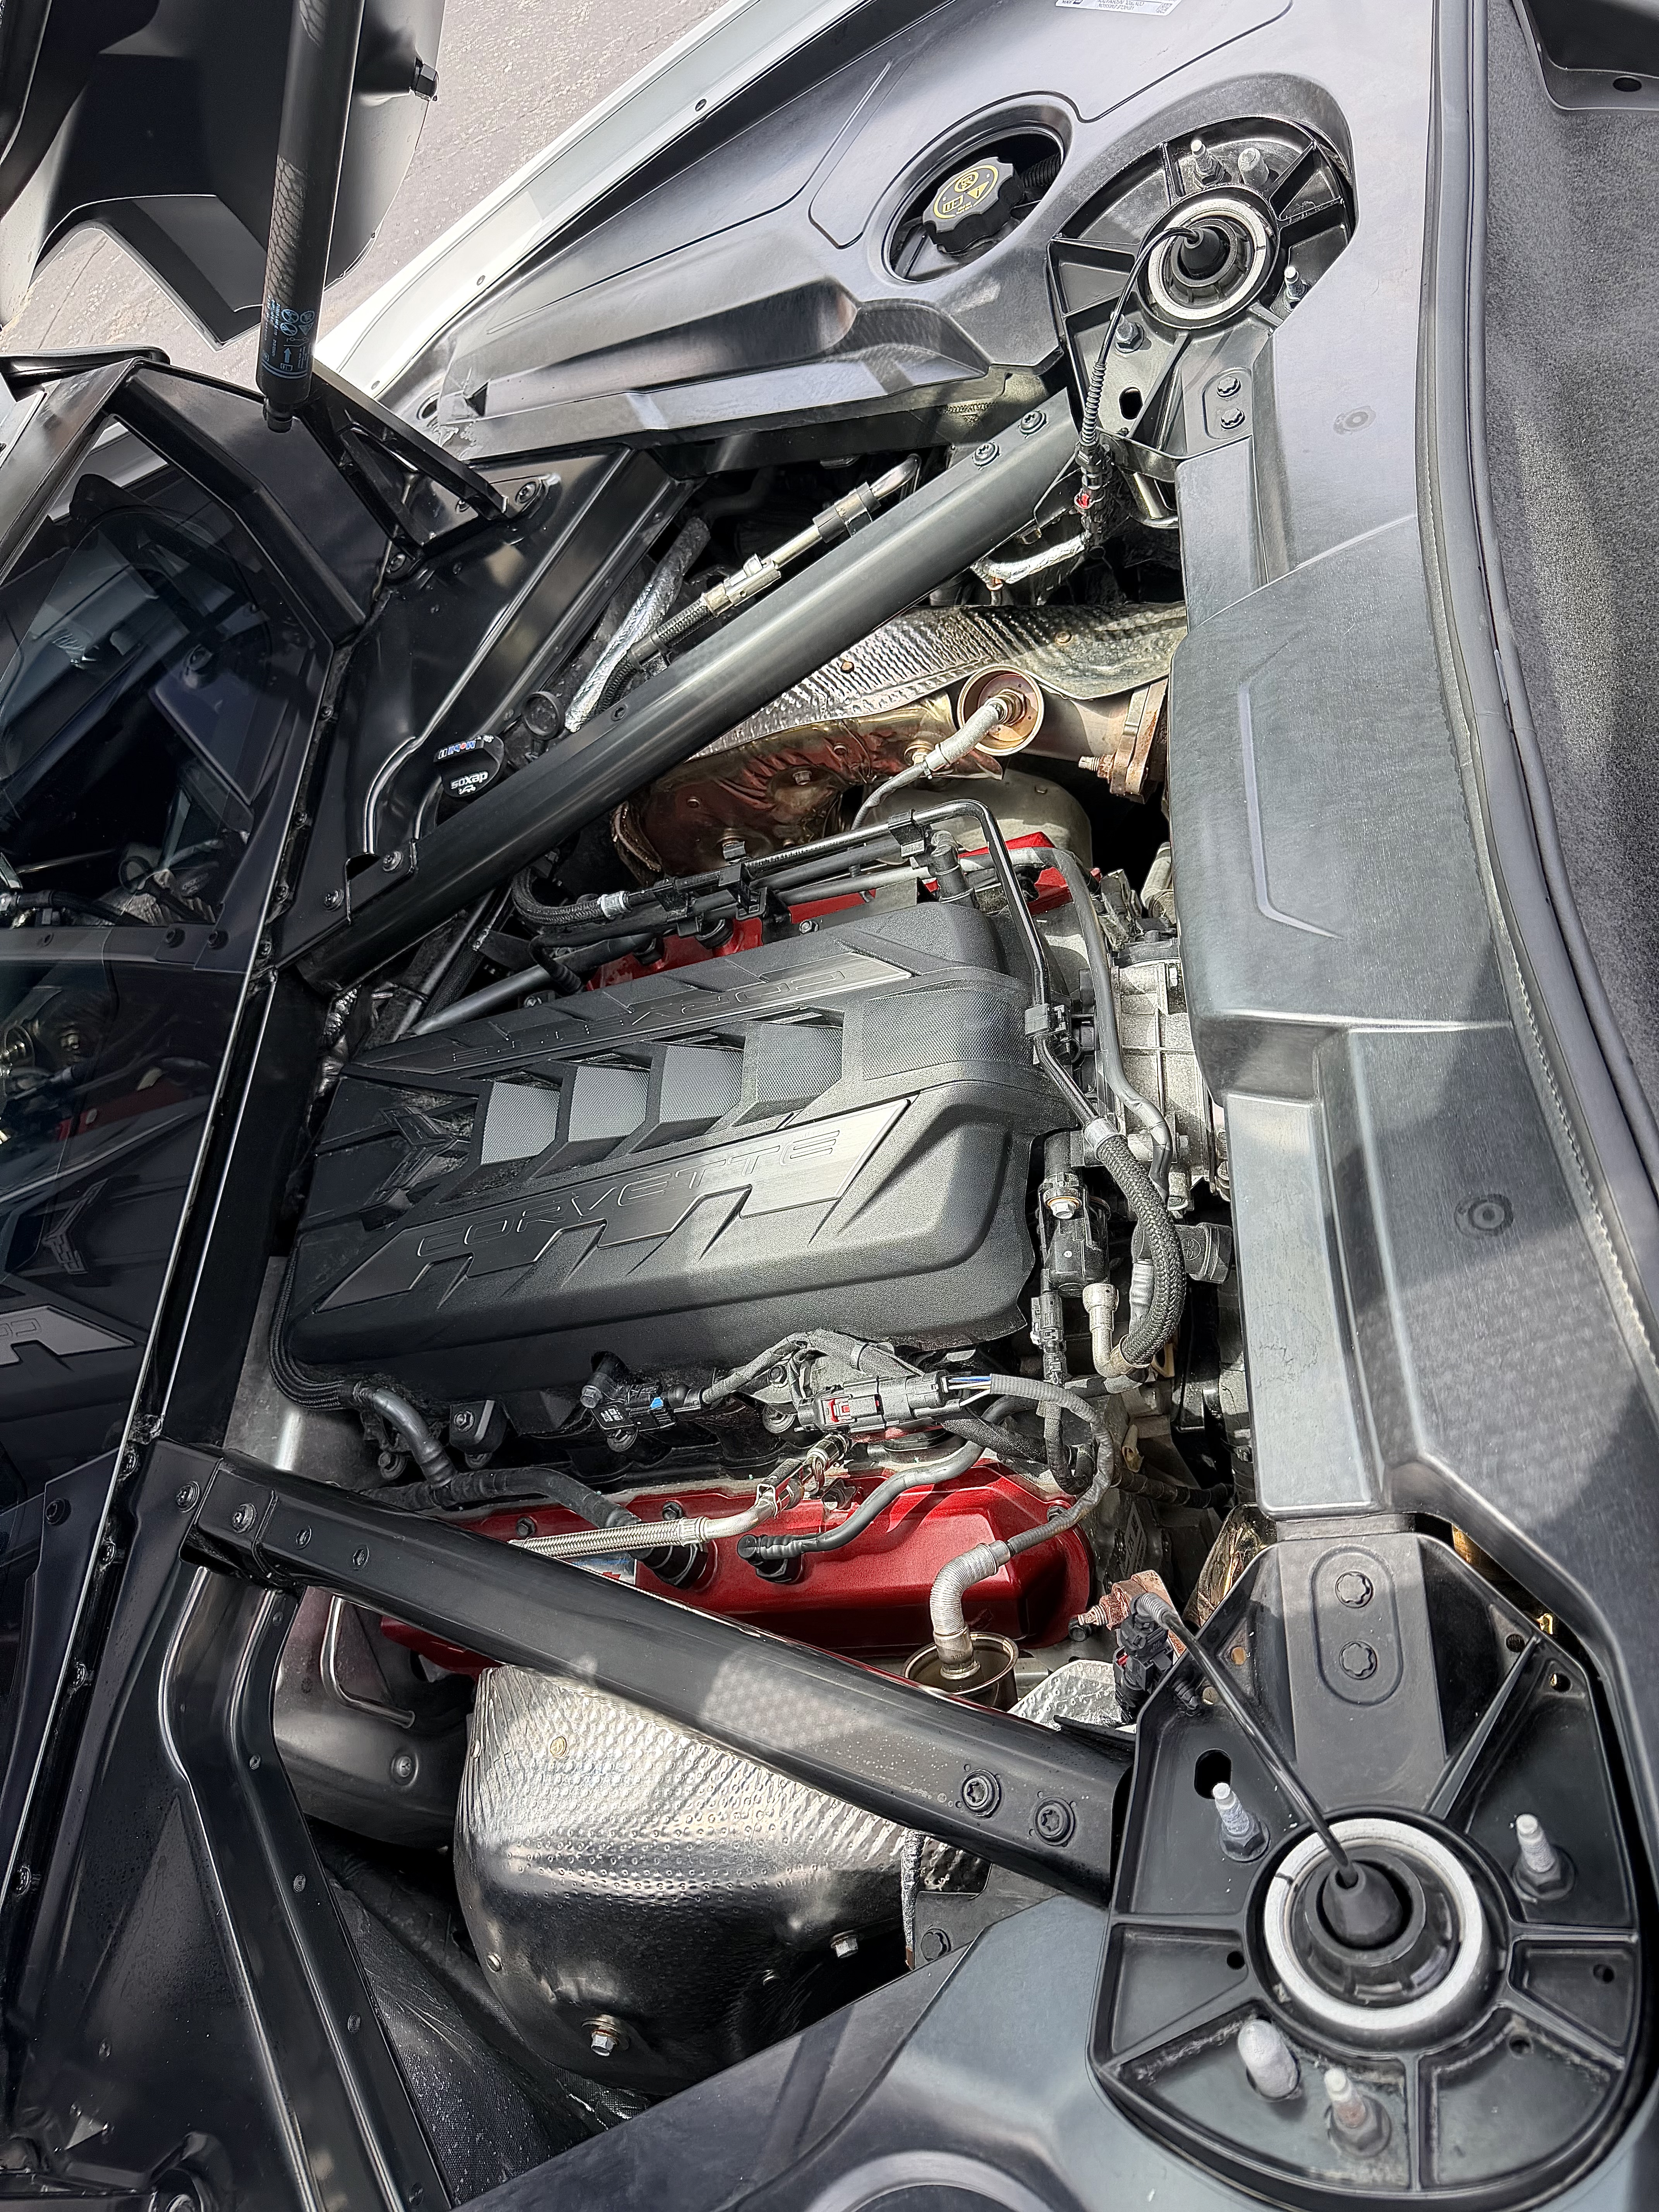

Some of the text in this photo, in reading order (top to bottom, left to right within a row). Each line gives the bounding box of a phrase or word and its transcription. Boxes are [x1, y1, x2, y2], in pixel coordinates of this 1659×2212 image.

[448, 740, 476, 755] Mobil
[450, 771, 488, 789] dexos
[417, 1130, 840, 1257] CORVETTE
